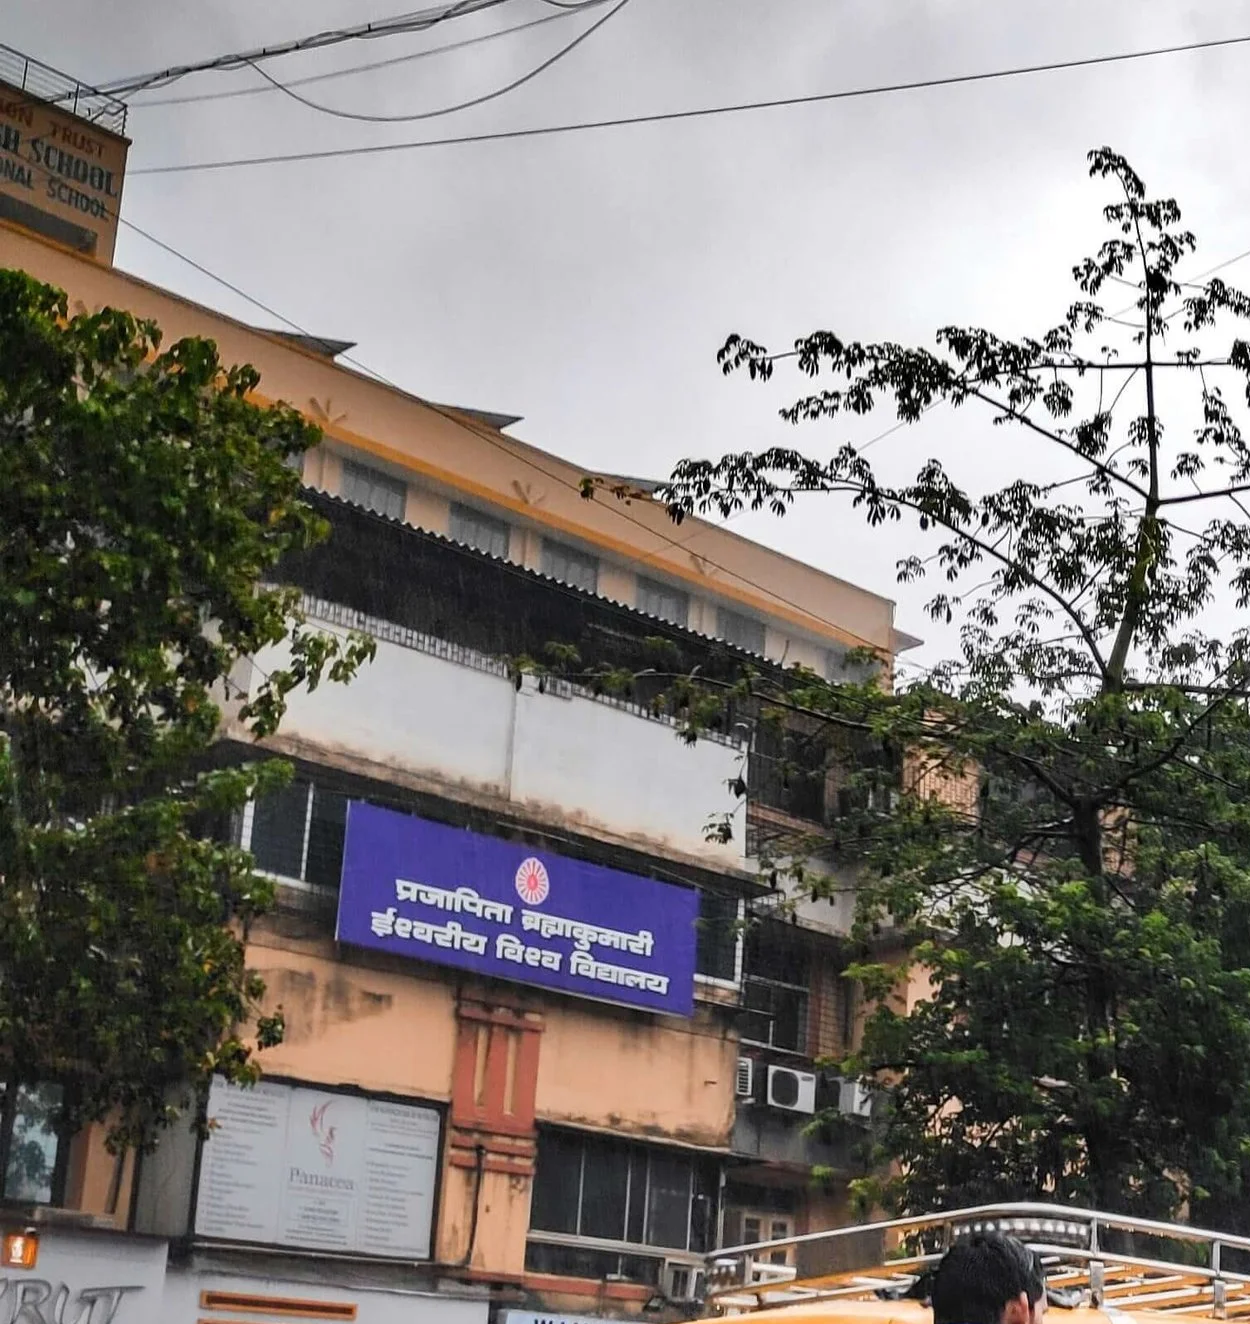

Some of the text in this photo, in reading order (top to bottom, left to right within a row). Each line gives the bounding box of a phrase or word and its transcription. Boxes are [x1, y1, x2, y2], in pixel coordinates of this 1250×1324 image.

[49, 120, 106, 157] TRUST
[29, 137, 118, 198] SCHOOL
[46, 176, 109, 222] SCHOOL
[395, 878, 655, 957] प्रजापिता ब्रह्माकुमारी
[371, 907, 670, 995] ईश्वरीय विश्व विद्यालय
[289, 1167, 355, 1191] Panacea
